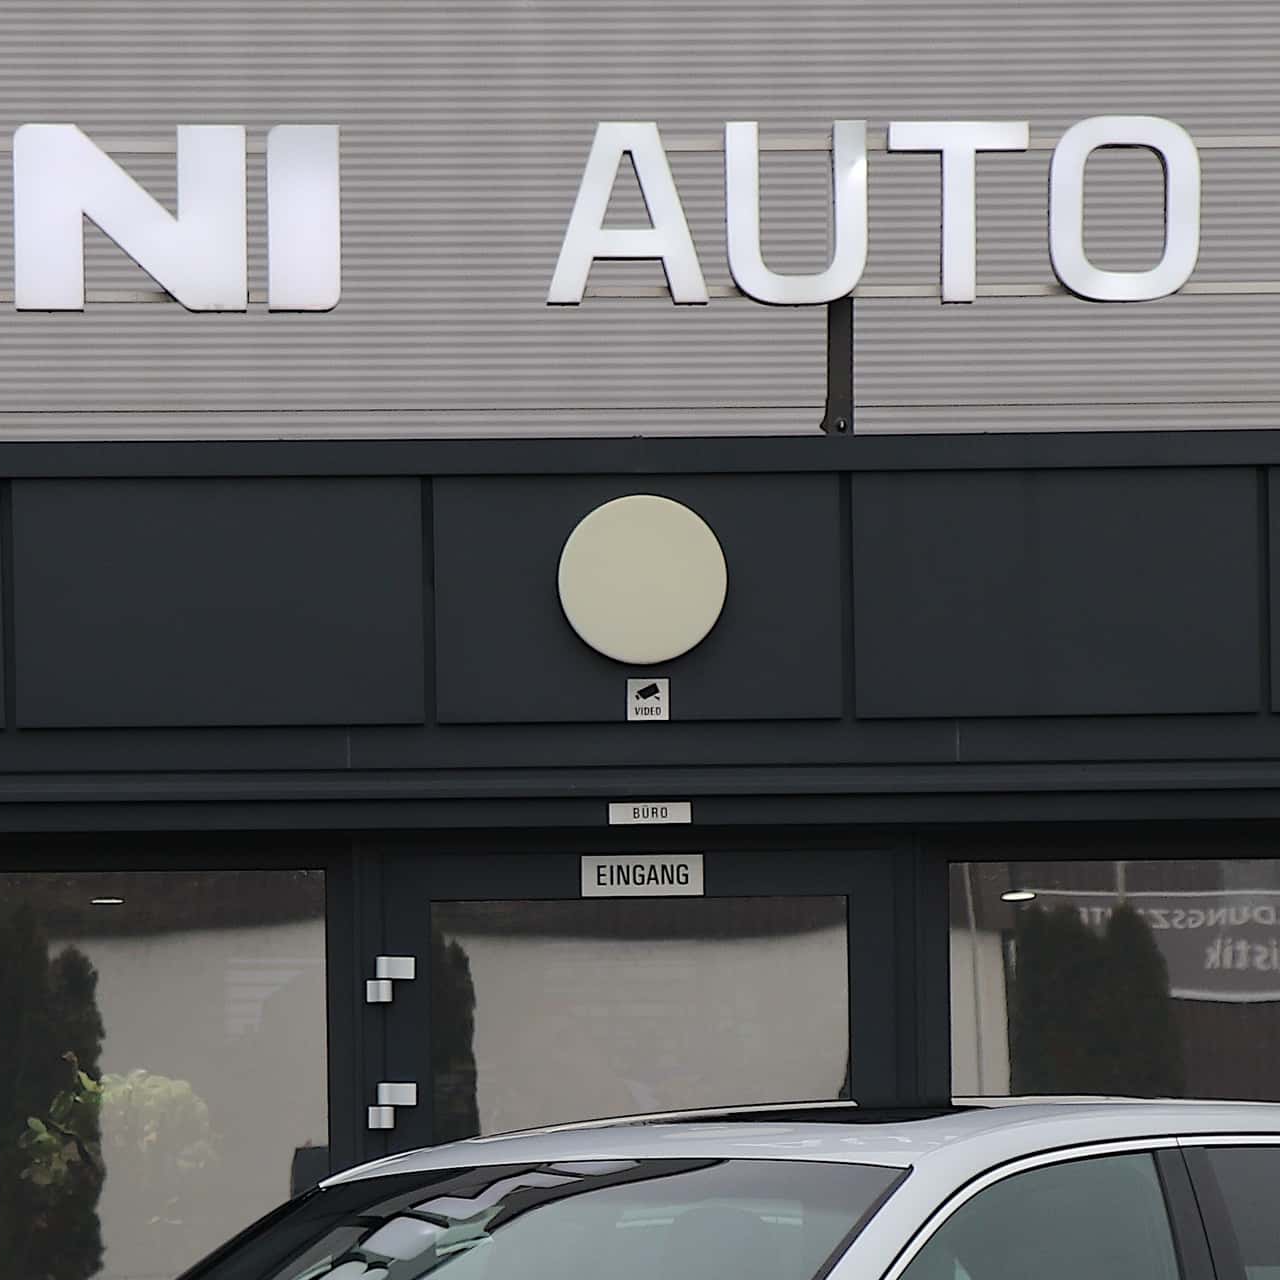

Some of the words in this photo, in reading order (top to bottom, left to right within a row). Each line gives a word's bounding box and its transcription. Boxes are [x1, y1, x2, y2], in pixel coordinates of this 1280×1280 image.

[546, 113, 1202, 308] AUTO
[634, 706, 662, 717] VIDEO
[632, 804, 669, 819] BÜRO
[596, 863, 689, 886] EINGANG
